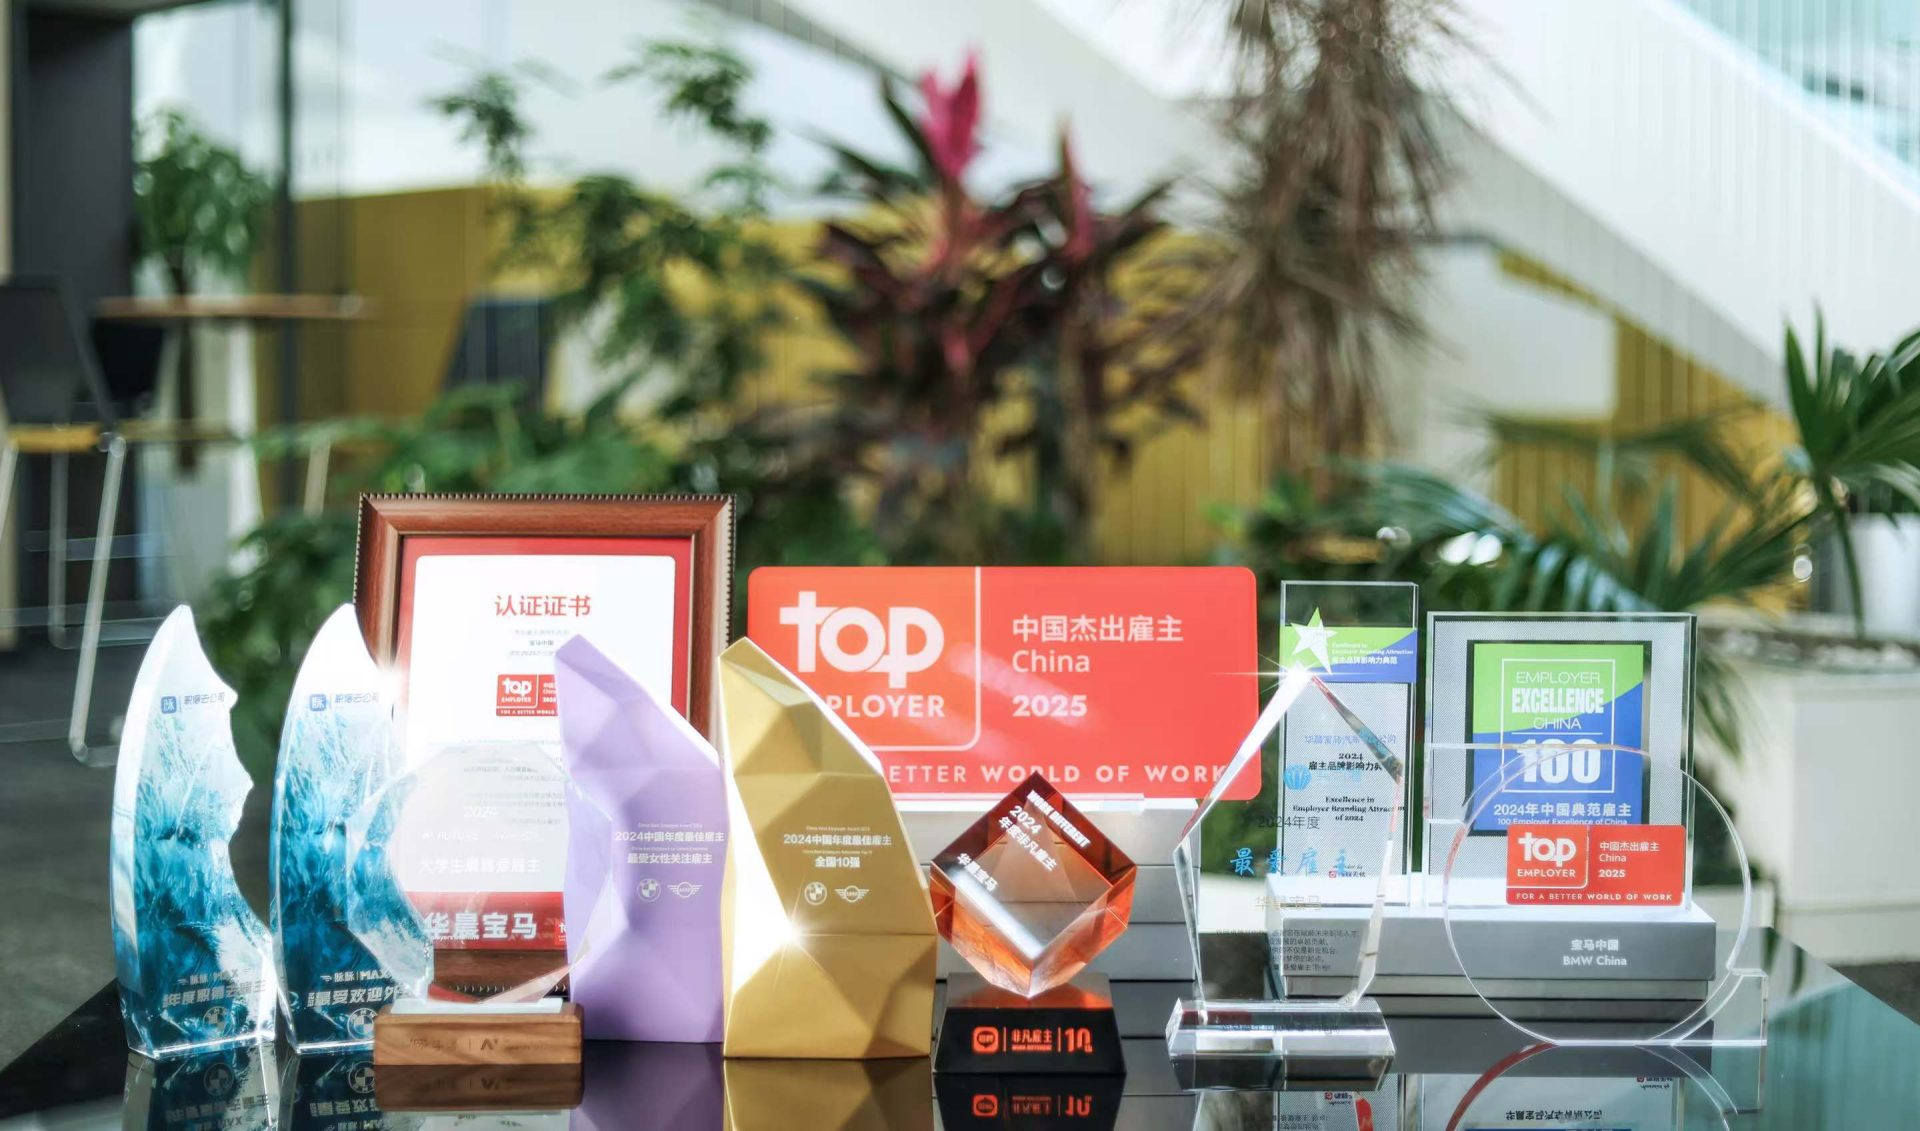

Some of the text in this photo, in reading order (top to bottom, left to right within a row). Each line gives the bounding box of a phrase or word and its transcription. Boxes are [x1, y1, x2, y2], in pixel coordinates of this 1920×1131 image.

[494, 595, 592, 618] 认证证书
[1012, 614, 1184, 643] 中国杰出雇主
[779, 591, 945, 689] top
[1012, 650, 1091, 673] China
[1516, 672, 1600, 684] EMPLOYER
[825, 694, 945, 718] PLOYER
[1012, 694, 1088, 718] 2025
[1511, 688, 1604, 714] EXCELLENCE
[1533, 717, 1582, 730] CHINA
[1516, 738, 1601, 784] 100
[889, 765, 967, 783] ETTER
[1095, 765, 1129, 782] OF
[1293, 805, 1330, 813] Employer
[1332, 805, 1366, 813] Branding
[1494, 802, 1632, 817] 2024年中国典范雇主
[1009, 805, 1042, 834] 2024
[615, 831, 725, 842] 2024中国年度最佳雇主
[783, 833, 892, 846] 2024中国年度最佳雇主
[999, 815, 1059, 872] 年度非凡雇主
[1518, 832, 1577, 867] top
[1600, 841, 1660, 852] 中国杰出雇主
[815, 856, 860, 868] 全国10强
[1599, 853, 1627, 863] China
[956, 852, 999, 892] 华晨宝马
[1517, 868, 1576, 878] EMPLOYER
[1599, 868, 1626, 878] 2025
[1516, 892, 1673, 901] FOR A BETTER WORLD OF WORK
[422, 911, 538, 940] 华晨宝马
[1570, 938, 1620, 952] 宝马中国
[1562, 955, 1628, 967] BMW China
[334, 971, 356, 983] 脉脉
